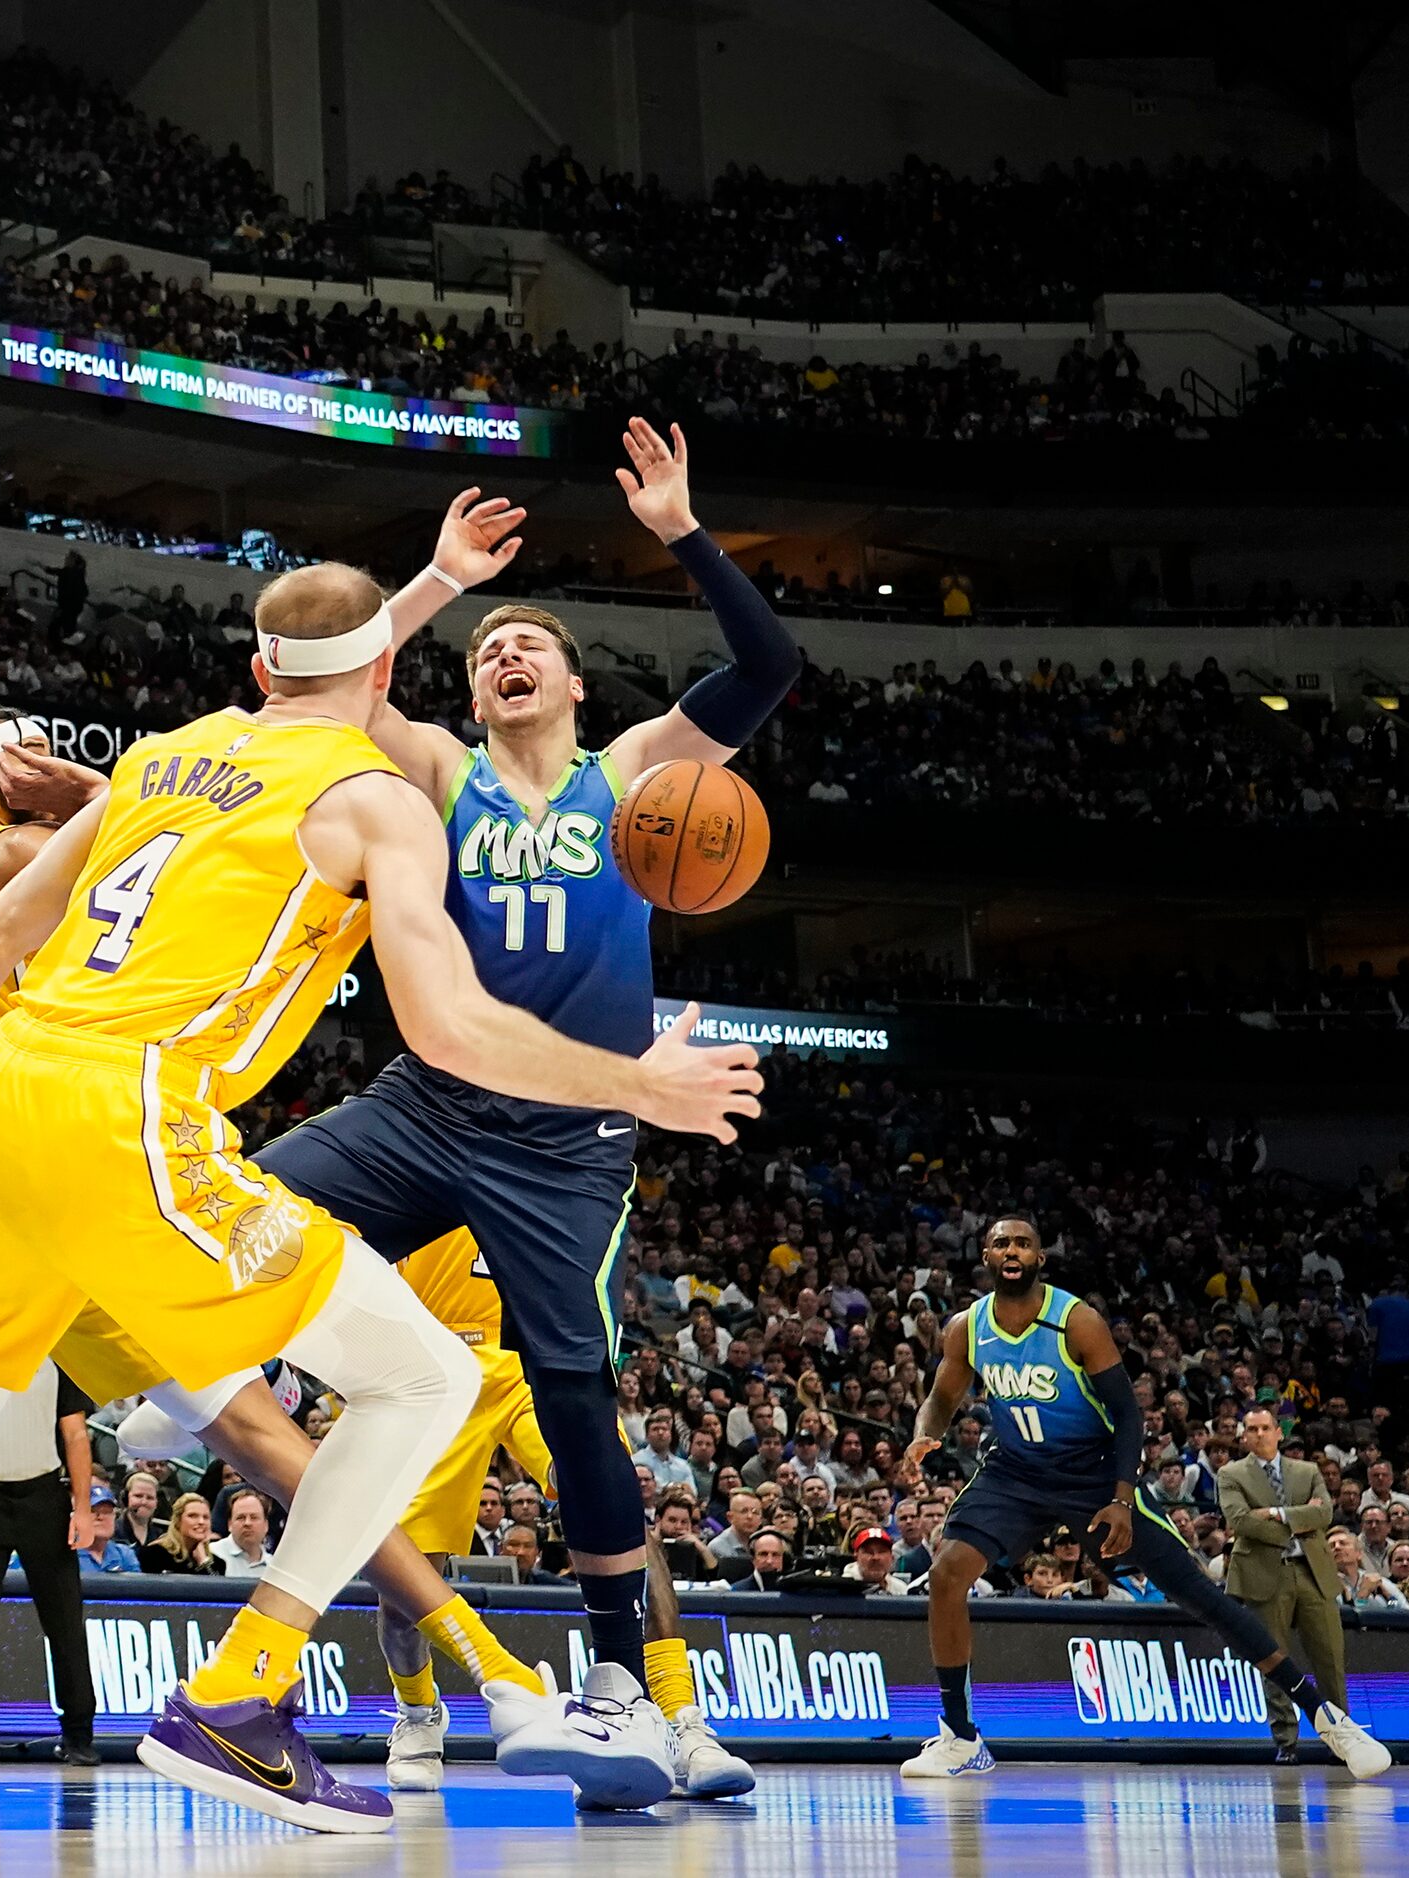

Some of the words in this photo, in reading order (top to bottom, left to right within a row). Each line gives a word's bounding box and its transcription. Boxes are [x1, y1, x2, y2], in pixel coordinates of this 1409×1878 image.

[1, 337, 38, 367] THE
[39, 345, 120, 382] OFFICIAL
[122, 359, 159, 388] LAW
[161, 368, 204, 398] FIRM
[206, 378, 282, 412] PARTNER
[283, 393, 309, 417] OF
[309, 396, 342, 424] THE
[344, 402, 411, 433] DALLAS
[412, 411, 522, 442] MAVERICKS
[140, 756, 265, 813] CARUSO
[458, 808, 605, 885] MAVS
[84, 830, 184, 974] 4
[488, 884, 567, 953] 77
[719, 1020, 783, 1044] DALLAS
[784, 1025, 889, 1050] MAVERICKS
[227, 1194, 311, 1292] LAKERS
[981, 1361, 1060, 1404] MAVS
[1009, 1405, 1045, 1443] 11
[85, 1618, 180, 1714] NBA
[1098, 1639, 1178, 1722] NBA
